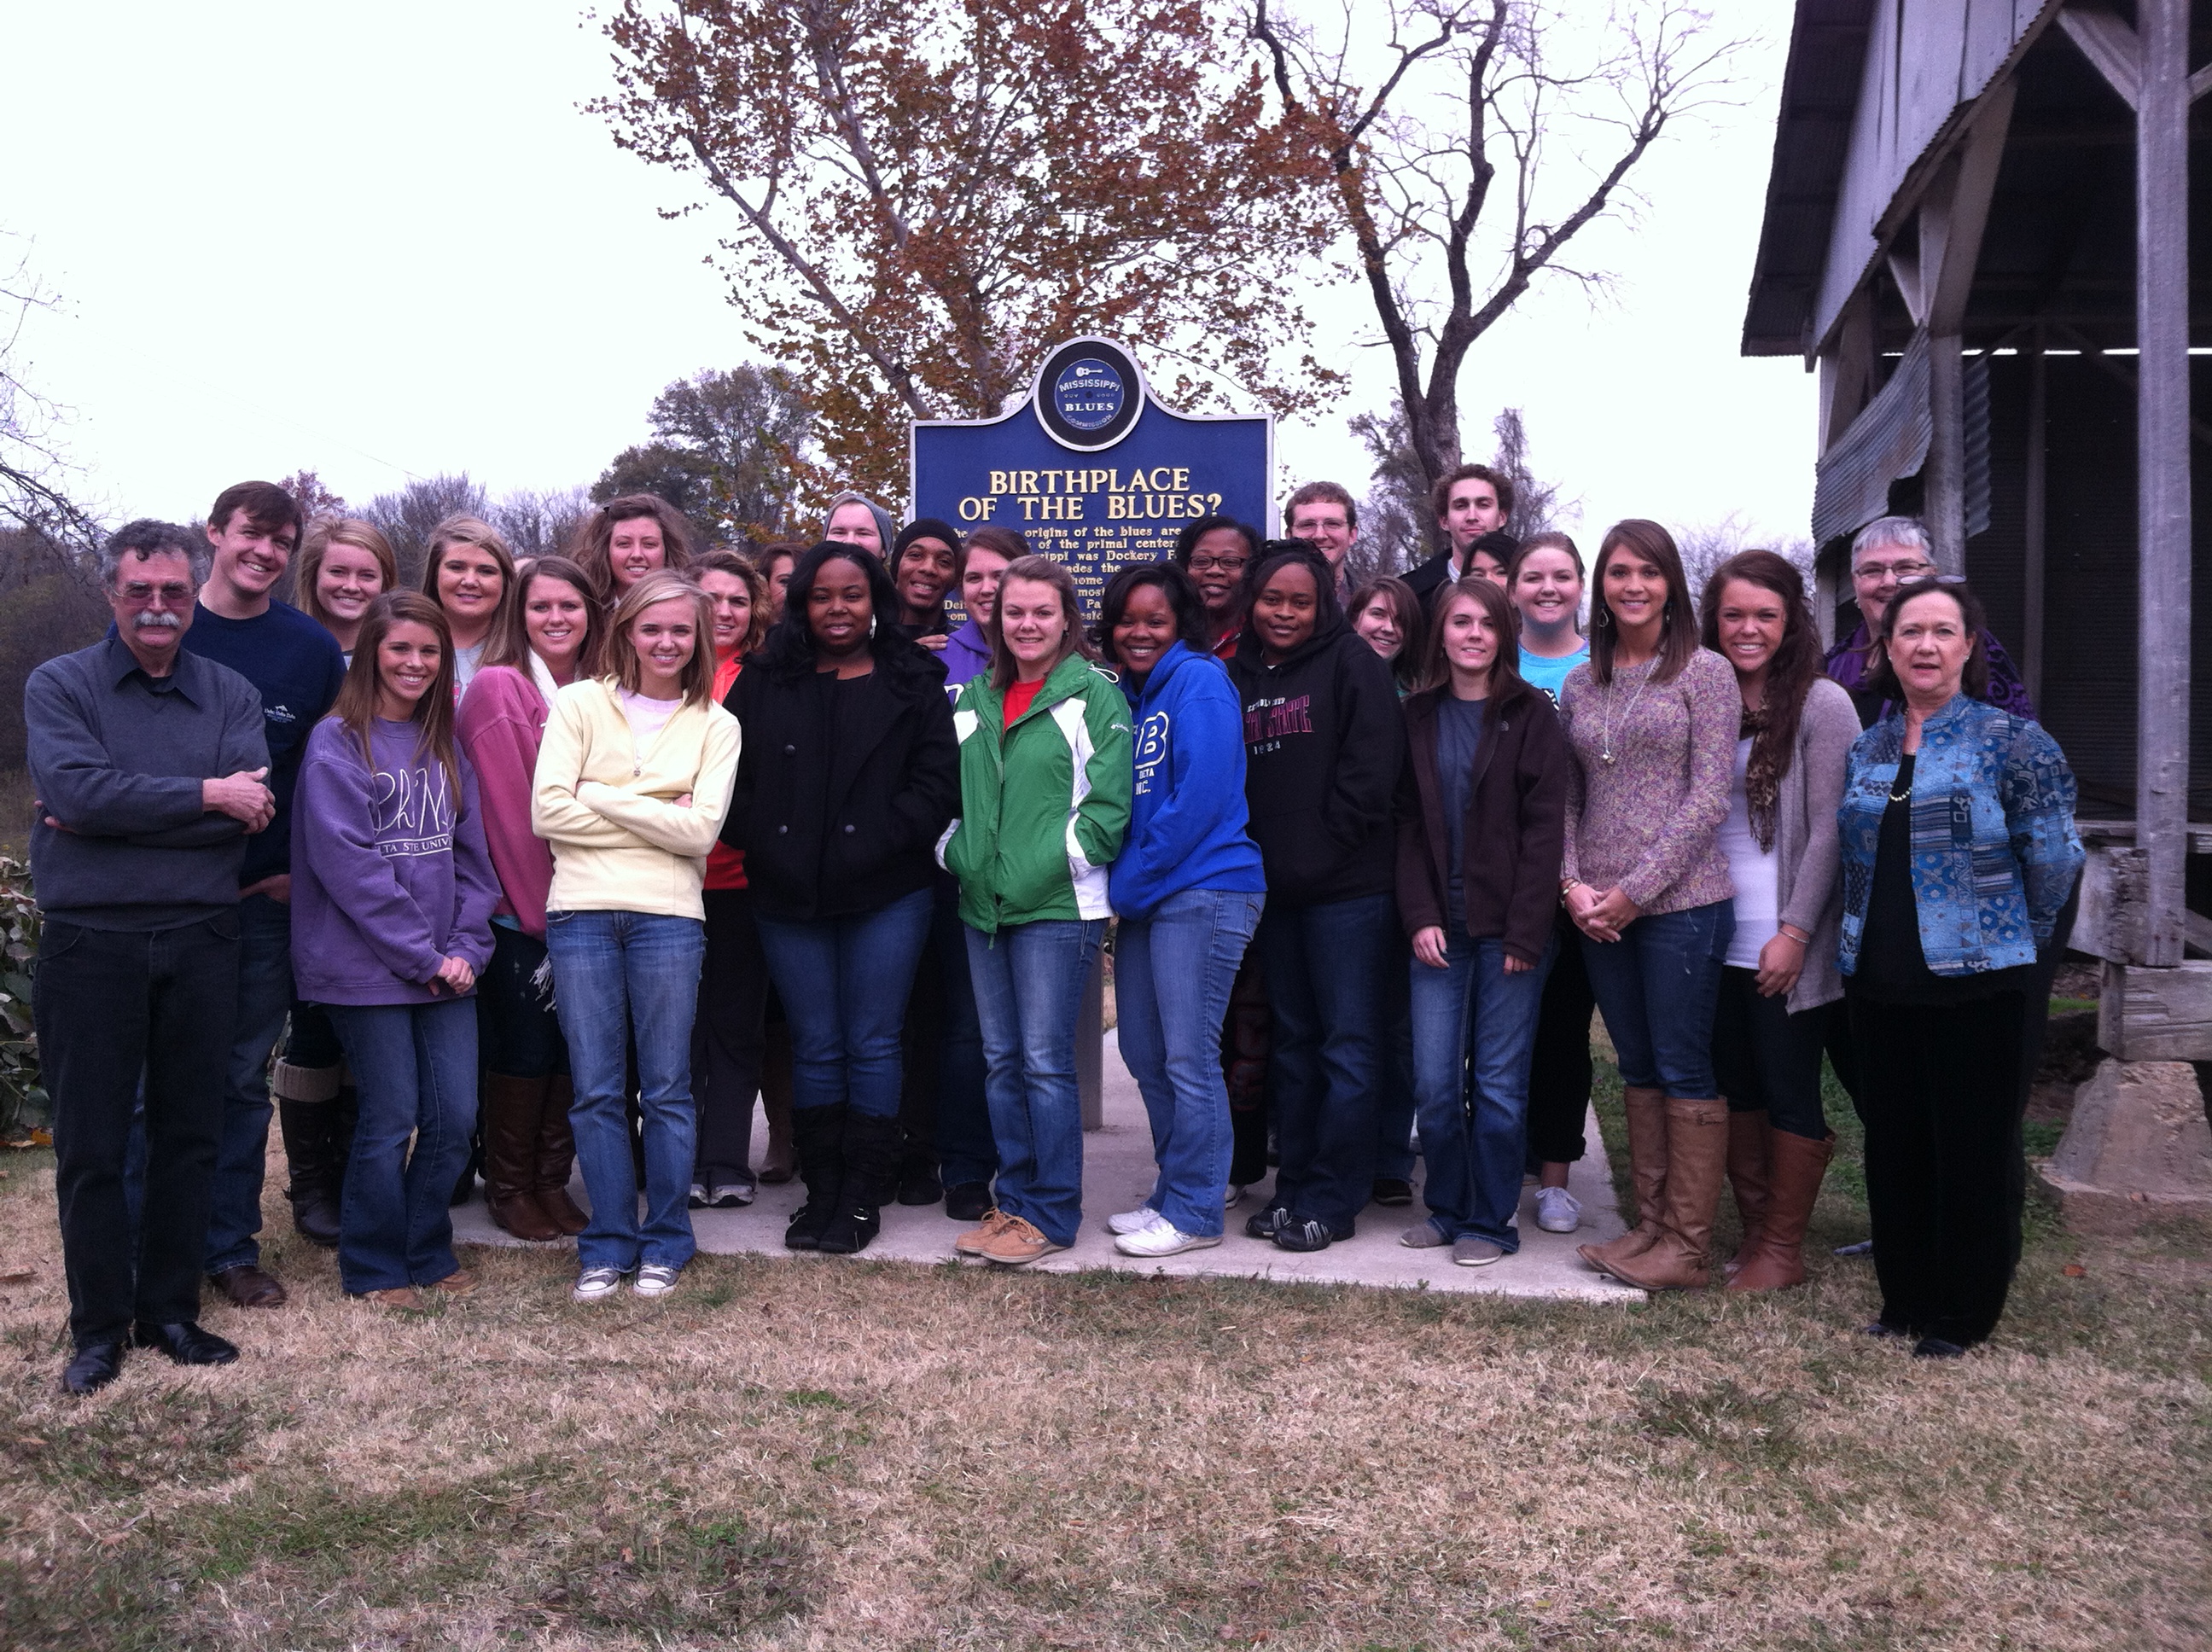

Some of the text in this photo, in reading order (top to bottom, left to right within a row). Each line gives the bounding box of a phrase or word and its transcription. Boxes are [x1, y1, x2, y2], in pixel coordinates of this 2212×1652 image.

[1059, 379, 1121, 393] MISSISSIPPI
[1064, 402, 1115, 411] BLUES
[989, 467, 1190, 495] BIRTHPLACE
[958, 493, 1223, 521] OF THE BLUES?
[953, 526, 1182, 539] he origins of the blues are
[1038, 539, 1052, 550] of
[1059, 538, 1080, 549] the
[1087, 538, 1128, 551] primal
[1106, 550, 1158, 562] Dockery
[1101, 562, 1121, 573] the
